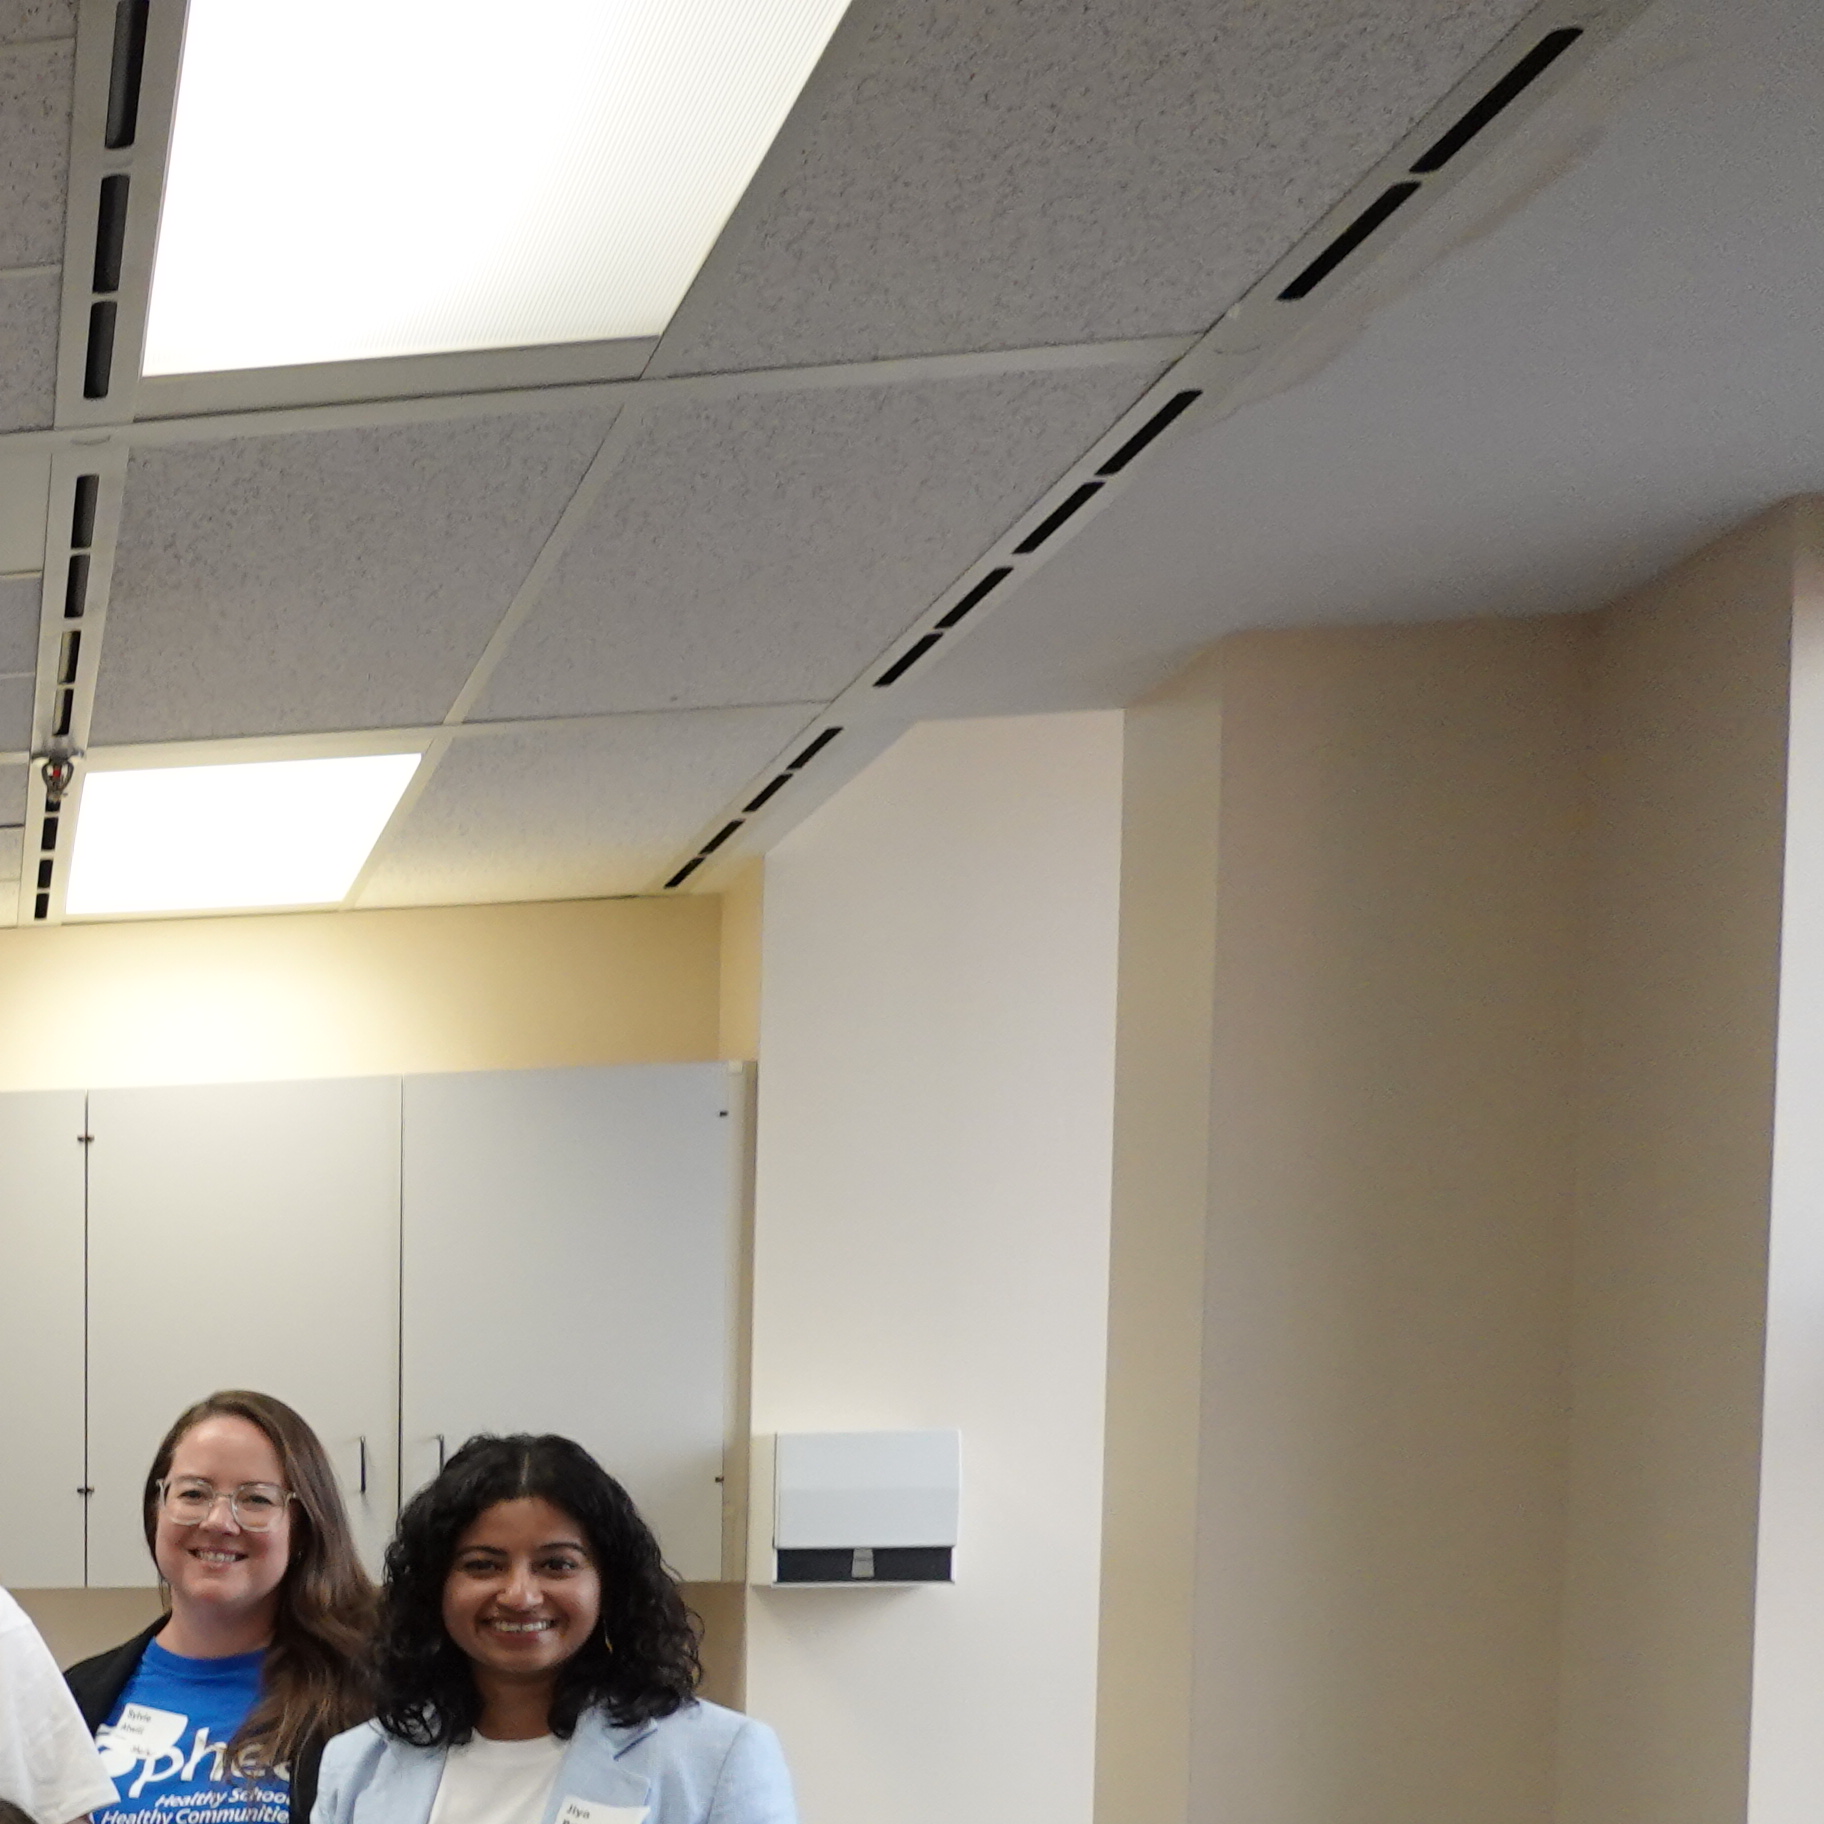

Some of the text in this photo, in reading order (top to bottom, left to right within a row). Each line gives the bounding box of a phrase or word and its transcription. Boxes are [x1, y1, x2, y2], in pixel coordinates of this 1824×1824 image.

[154, 1790, 228, 1809] Healthy
[175, 1804, 291, 1824] Communitie
[566, 1803, 591, 1820] Jiya
